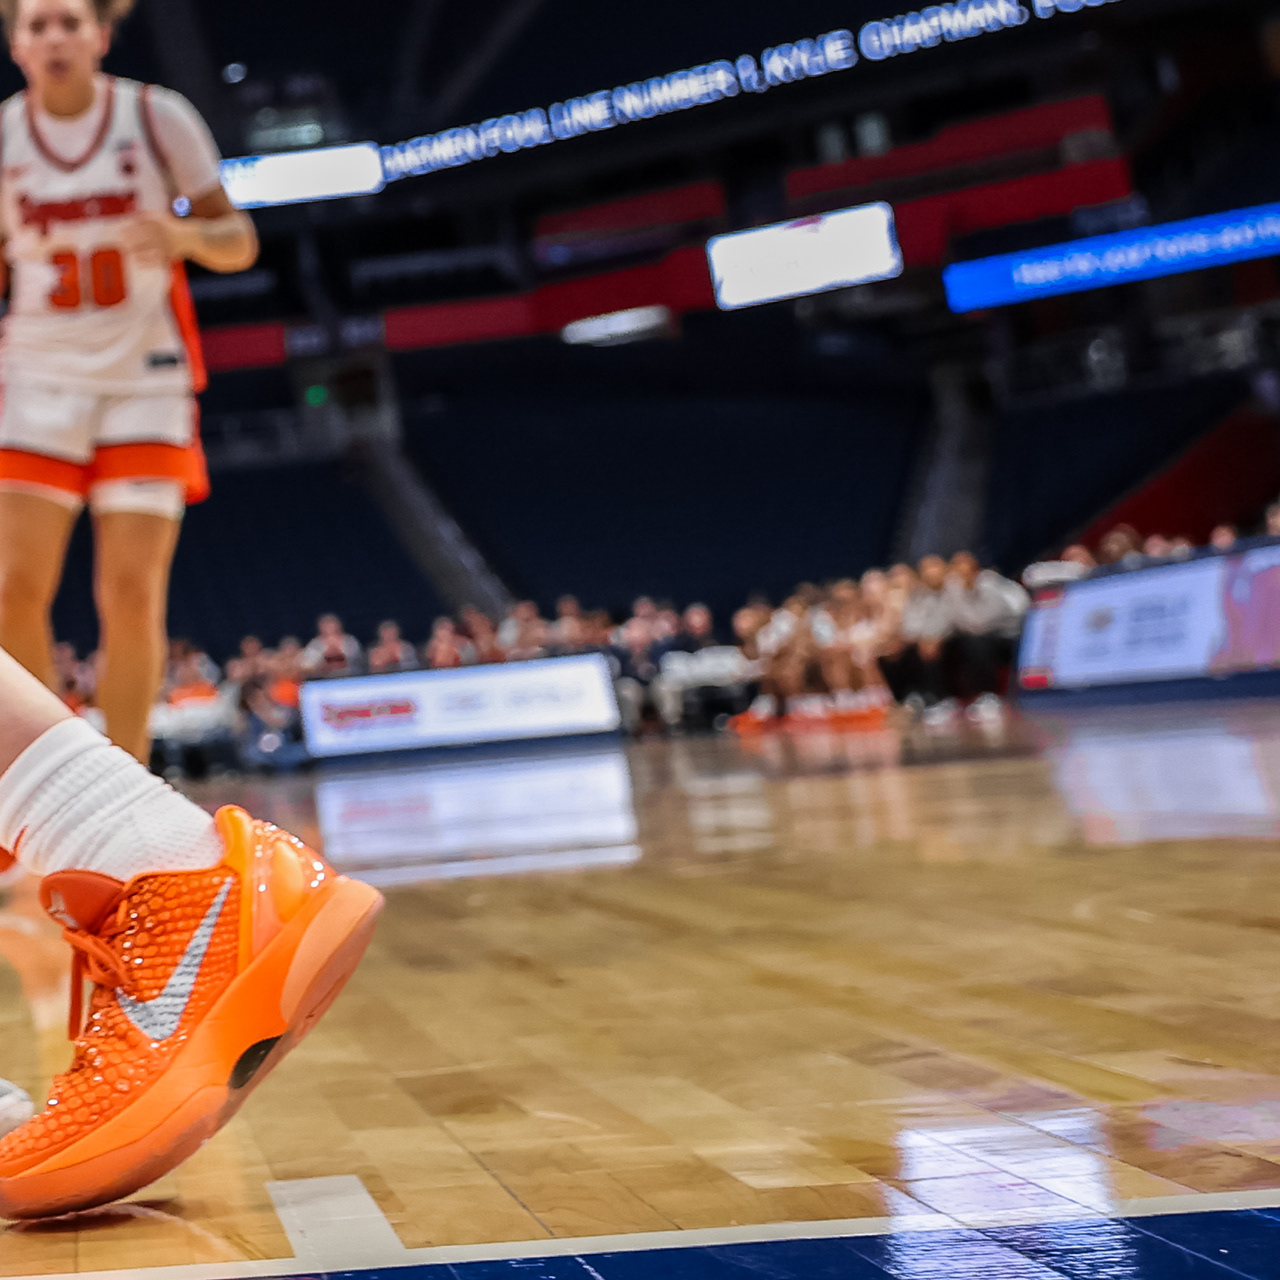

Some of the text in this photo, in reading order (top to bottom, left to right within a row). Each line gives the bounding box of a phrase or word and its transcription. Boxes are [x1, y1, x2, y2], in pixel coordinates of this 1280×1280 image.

[612, 59, 739, 123] NUMBER
[761, 29, 858, 86] KYLE
[50, 248, 127, 308] 30
